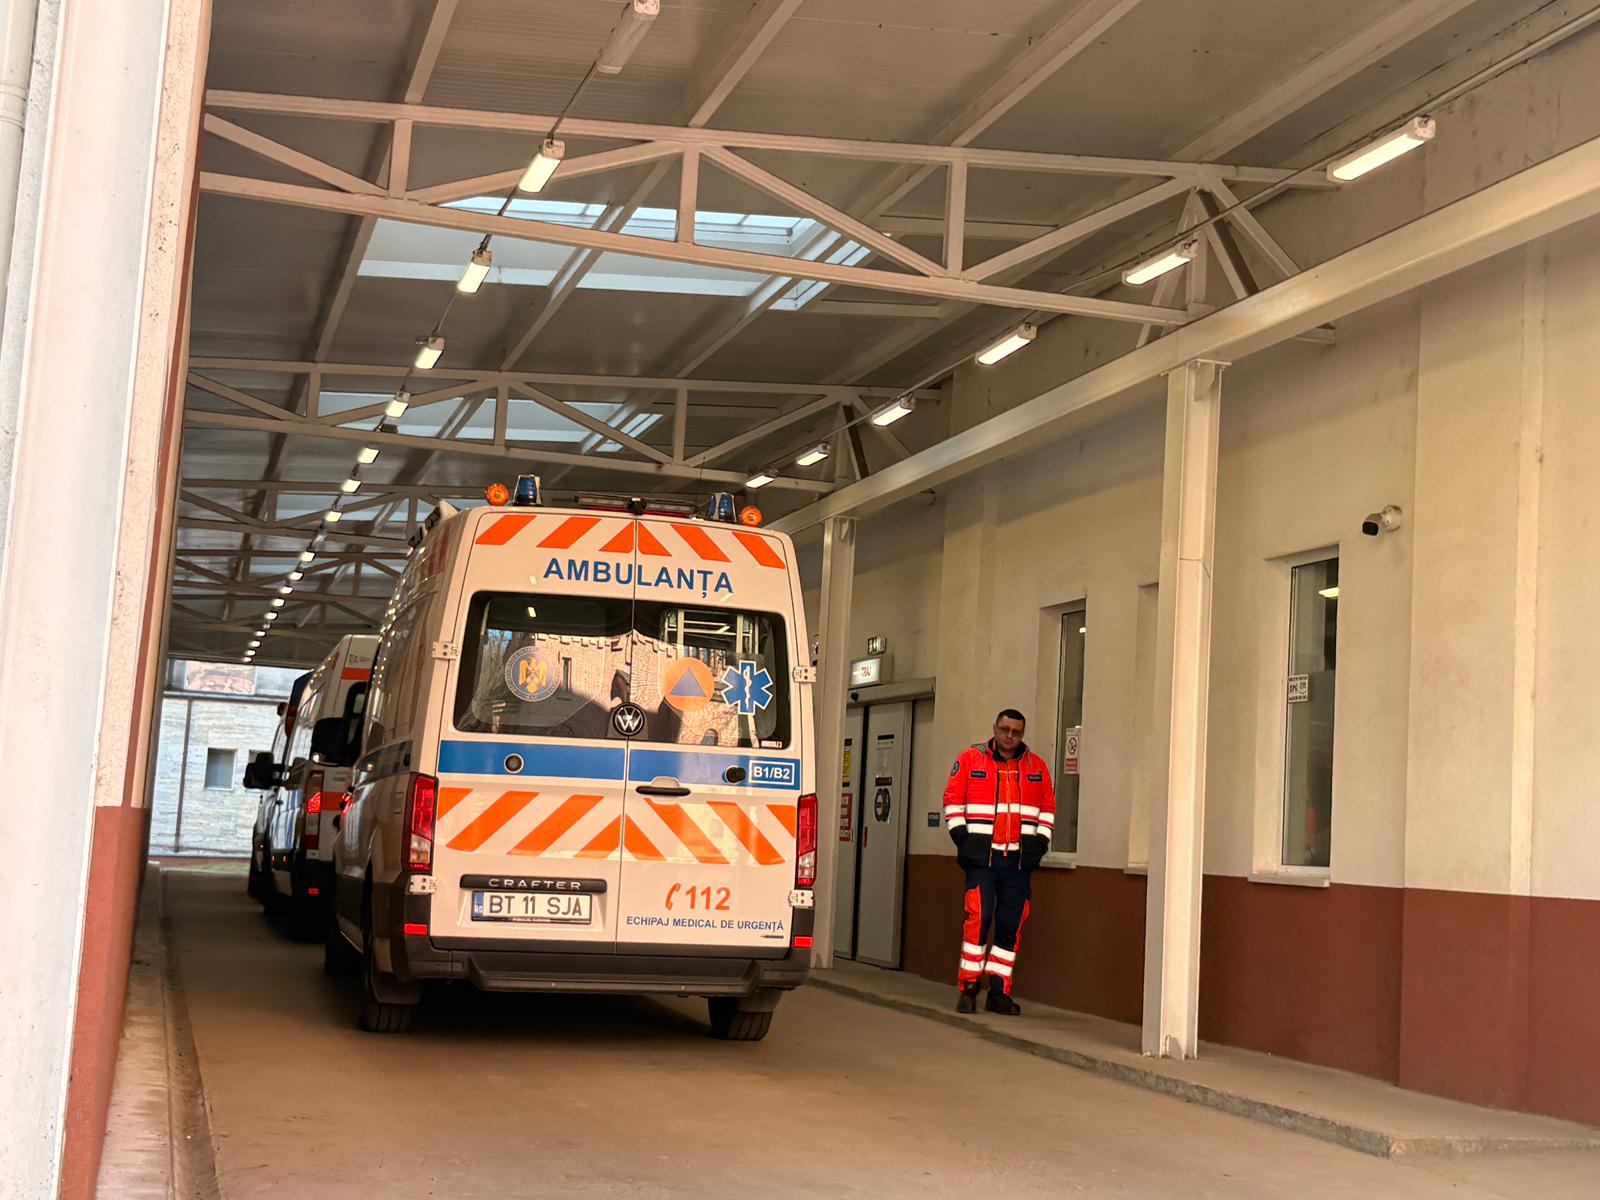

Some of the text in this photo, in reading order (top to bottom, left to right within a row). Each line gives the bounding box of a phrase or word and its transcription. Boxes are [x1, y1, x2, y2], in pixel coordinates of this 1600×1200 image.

[543, 557, 733, 599] AMBULANȚA
[753, 766, 790, 780] B1/B2
[488, 878, 581, 890] CRAFTER
[489, 895, 583, 916] BT 11 SJA
[685, 885, 731, 911] 112
[626, 916, 670, 927] ECHIPAJ
[672, 918, 717, 929] MEDICAL
[720, 919, 734, 929] DE
